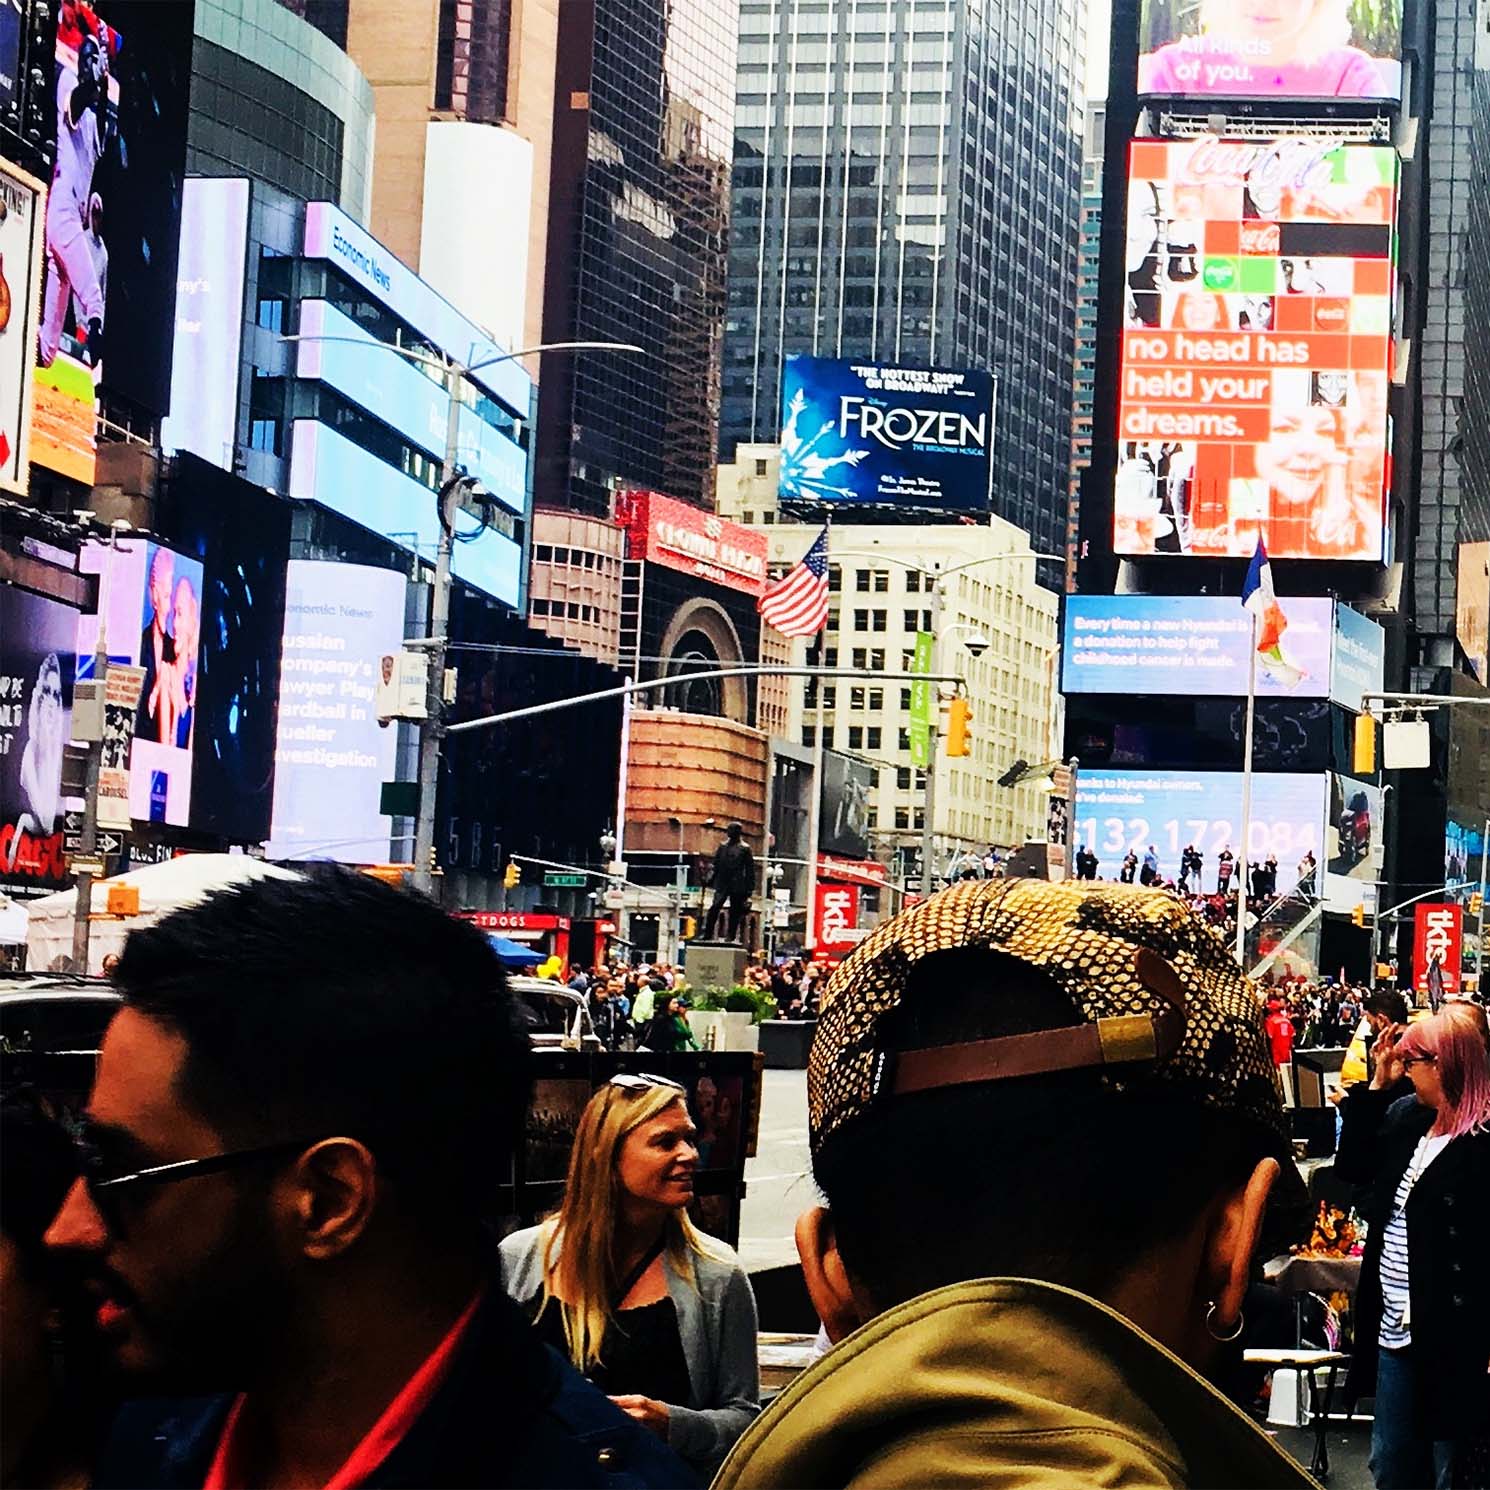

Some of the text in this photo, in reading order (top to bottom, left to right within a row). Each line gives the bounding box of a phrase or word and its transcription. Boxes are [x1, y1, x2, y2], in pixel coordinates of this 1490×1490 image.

[1208, 34, 1272, 56] kinds
[1175, 60, 1254, 87] of you.
[333, 226, 391, 293] Economic News
[1129, 335, 1310, 363] no head has
[865, 378, 883, 390] ON
[880, 368, 930, 383] HOTTEST
[932, 371, 965, 385] SHOW
[1127, 371, 1268, 407] held your
[840, 396, 986, 450] FROZEN
[1125, 407, 1244, 436] dreams.
[1073, 616, 1110, 632] Every
[1111, 616, 1140, 631] time
[1142, 619, 1150, 631] a
[1152, 619, 1180, 631] new
[1073, 635, 1220, 651] a donation to help fight
[279, 700, 366, 722] ardball in
[278, 723, 336, 742] ueller
[1426, 909, 1455, 967] tkts
